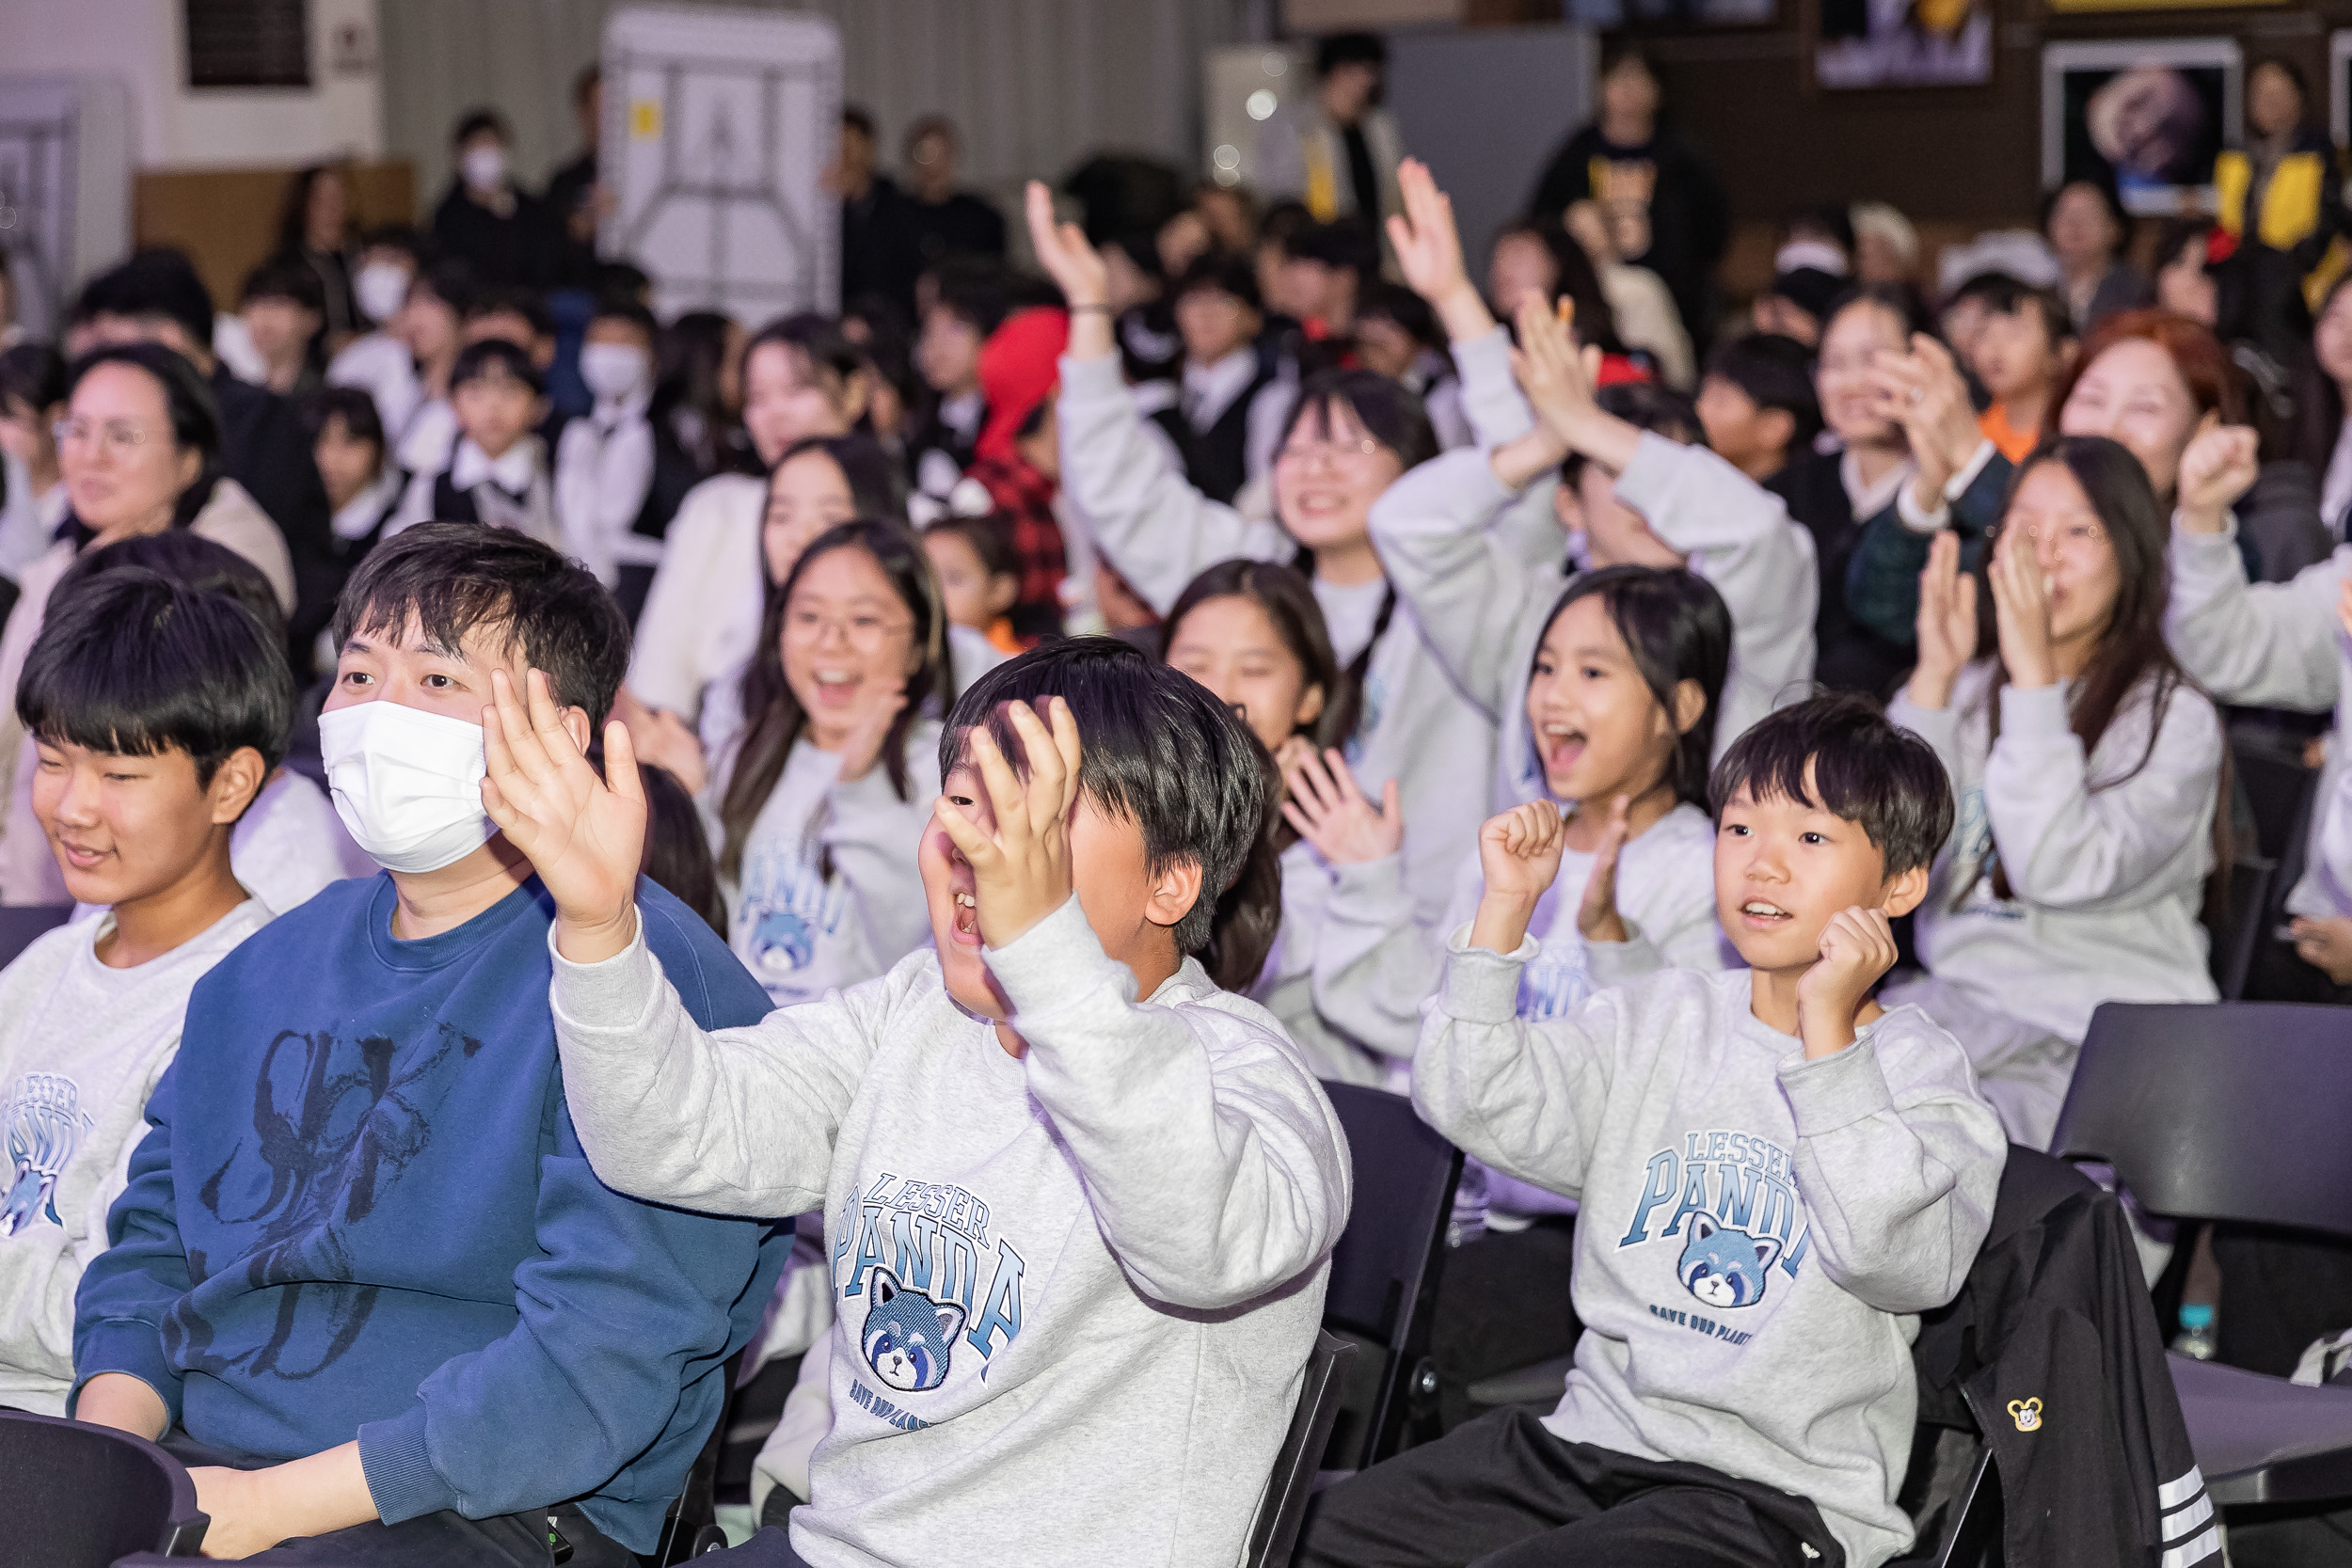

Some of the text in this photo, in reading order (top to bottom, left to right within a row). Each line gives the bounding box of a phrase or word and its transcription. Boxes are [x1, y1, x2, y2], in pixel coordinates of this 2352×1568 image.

[863, 1172, 991, 1250] LESSER
[833, 1185, 1025, 1361] PANDA
[1690, 1315, 1716, 1336] OUR
[849, 1379, 874, 1410] SAVE
